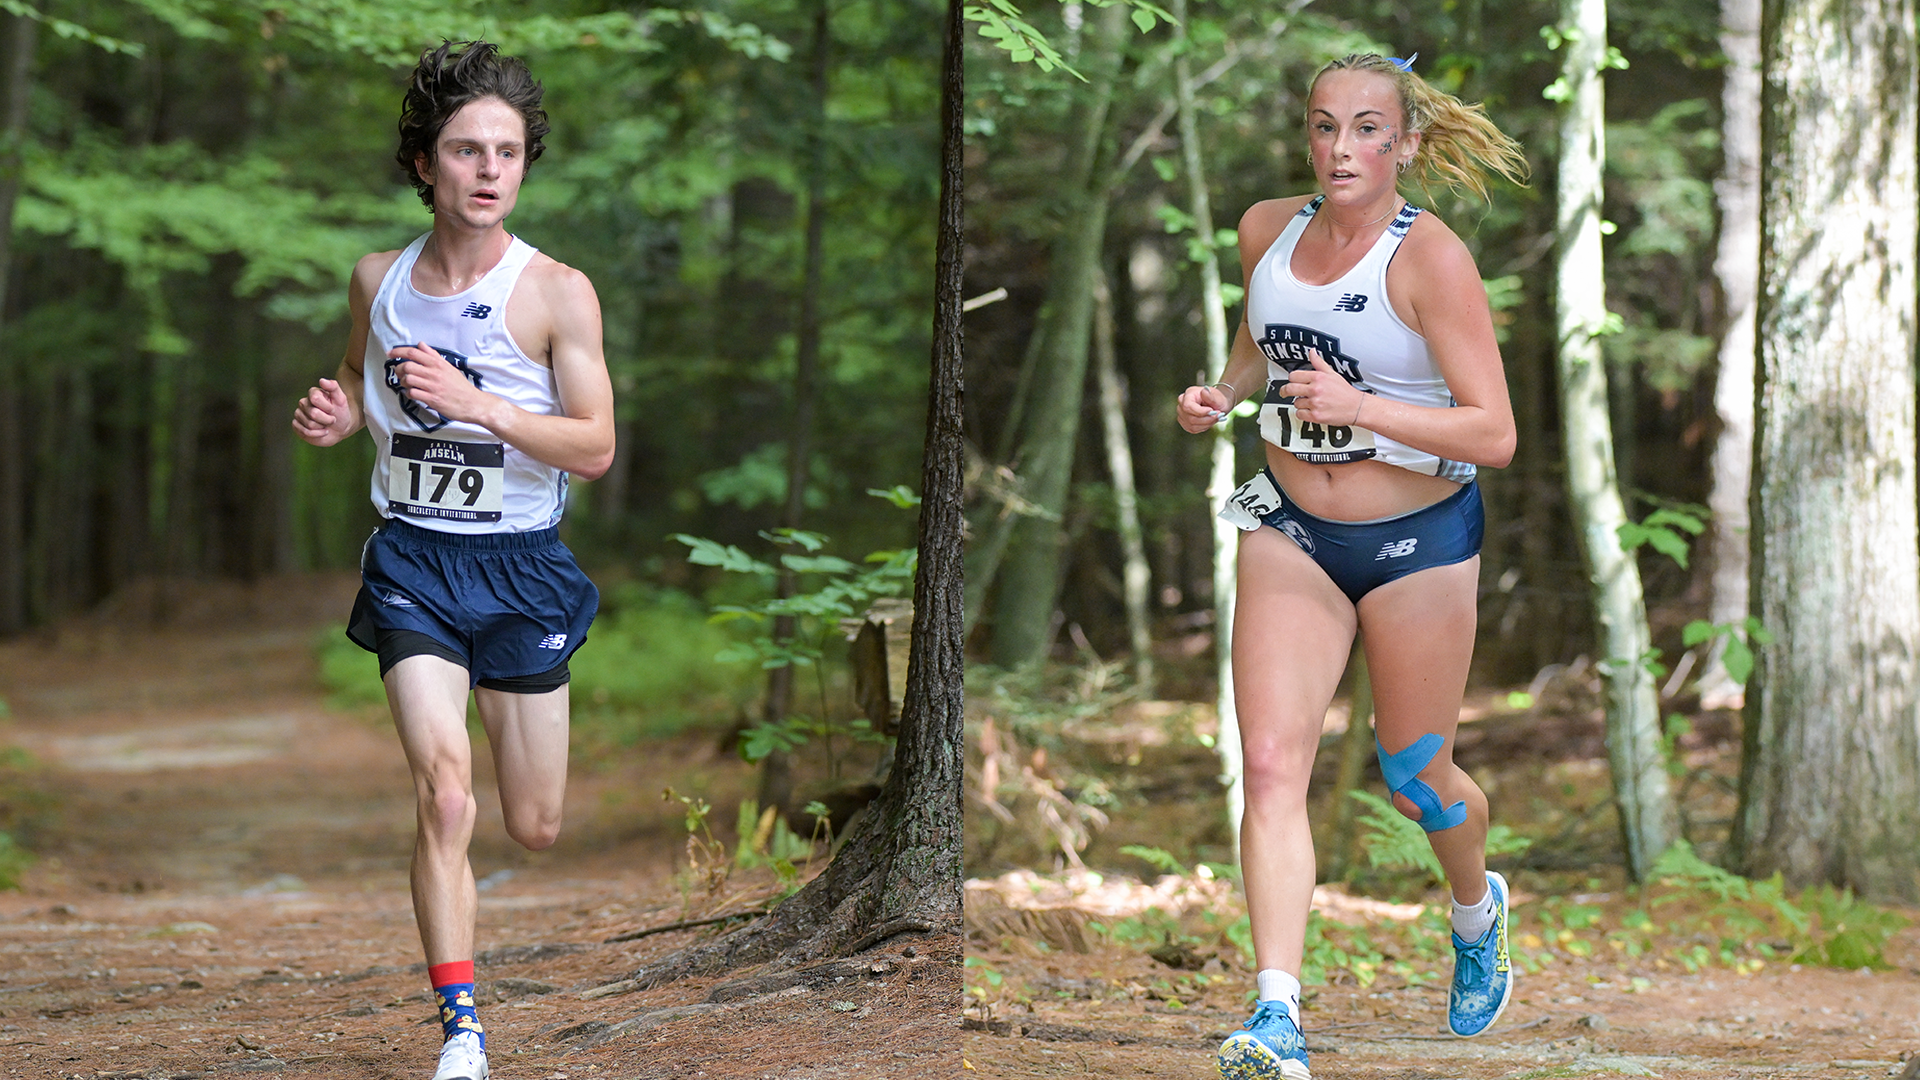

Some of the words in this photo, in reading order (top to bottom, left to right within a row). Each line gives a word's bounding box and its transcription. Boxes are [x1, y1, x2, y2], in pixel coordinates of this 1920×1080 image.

[1270, 329, 1333, 352] SAINT
[423, 448, 466, 465] ANSELM
[408, 462, 484, 506] 179
[1230, 484, 1270, 520] 146
[1496, 902, 1510, 973] HOKA
